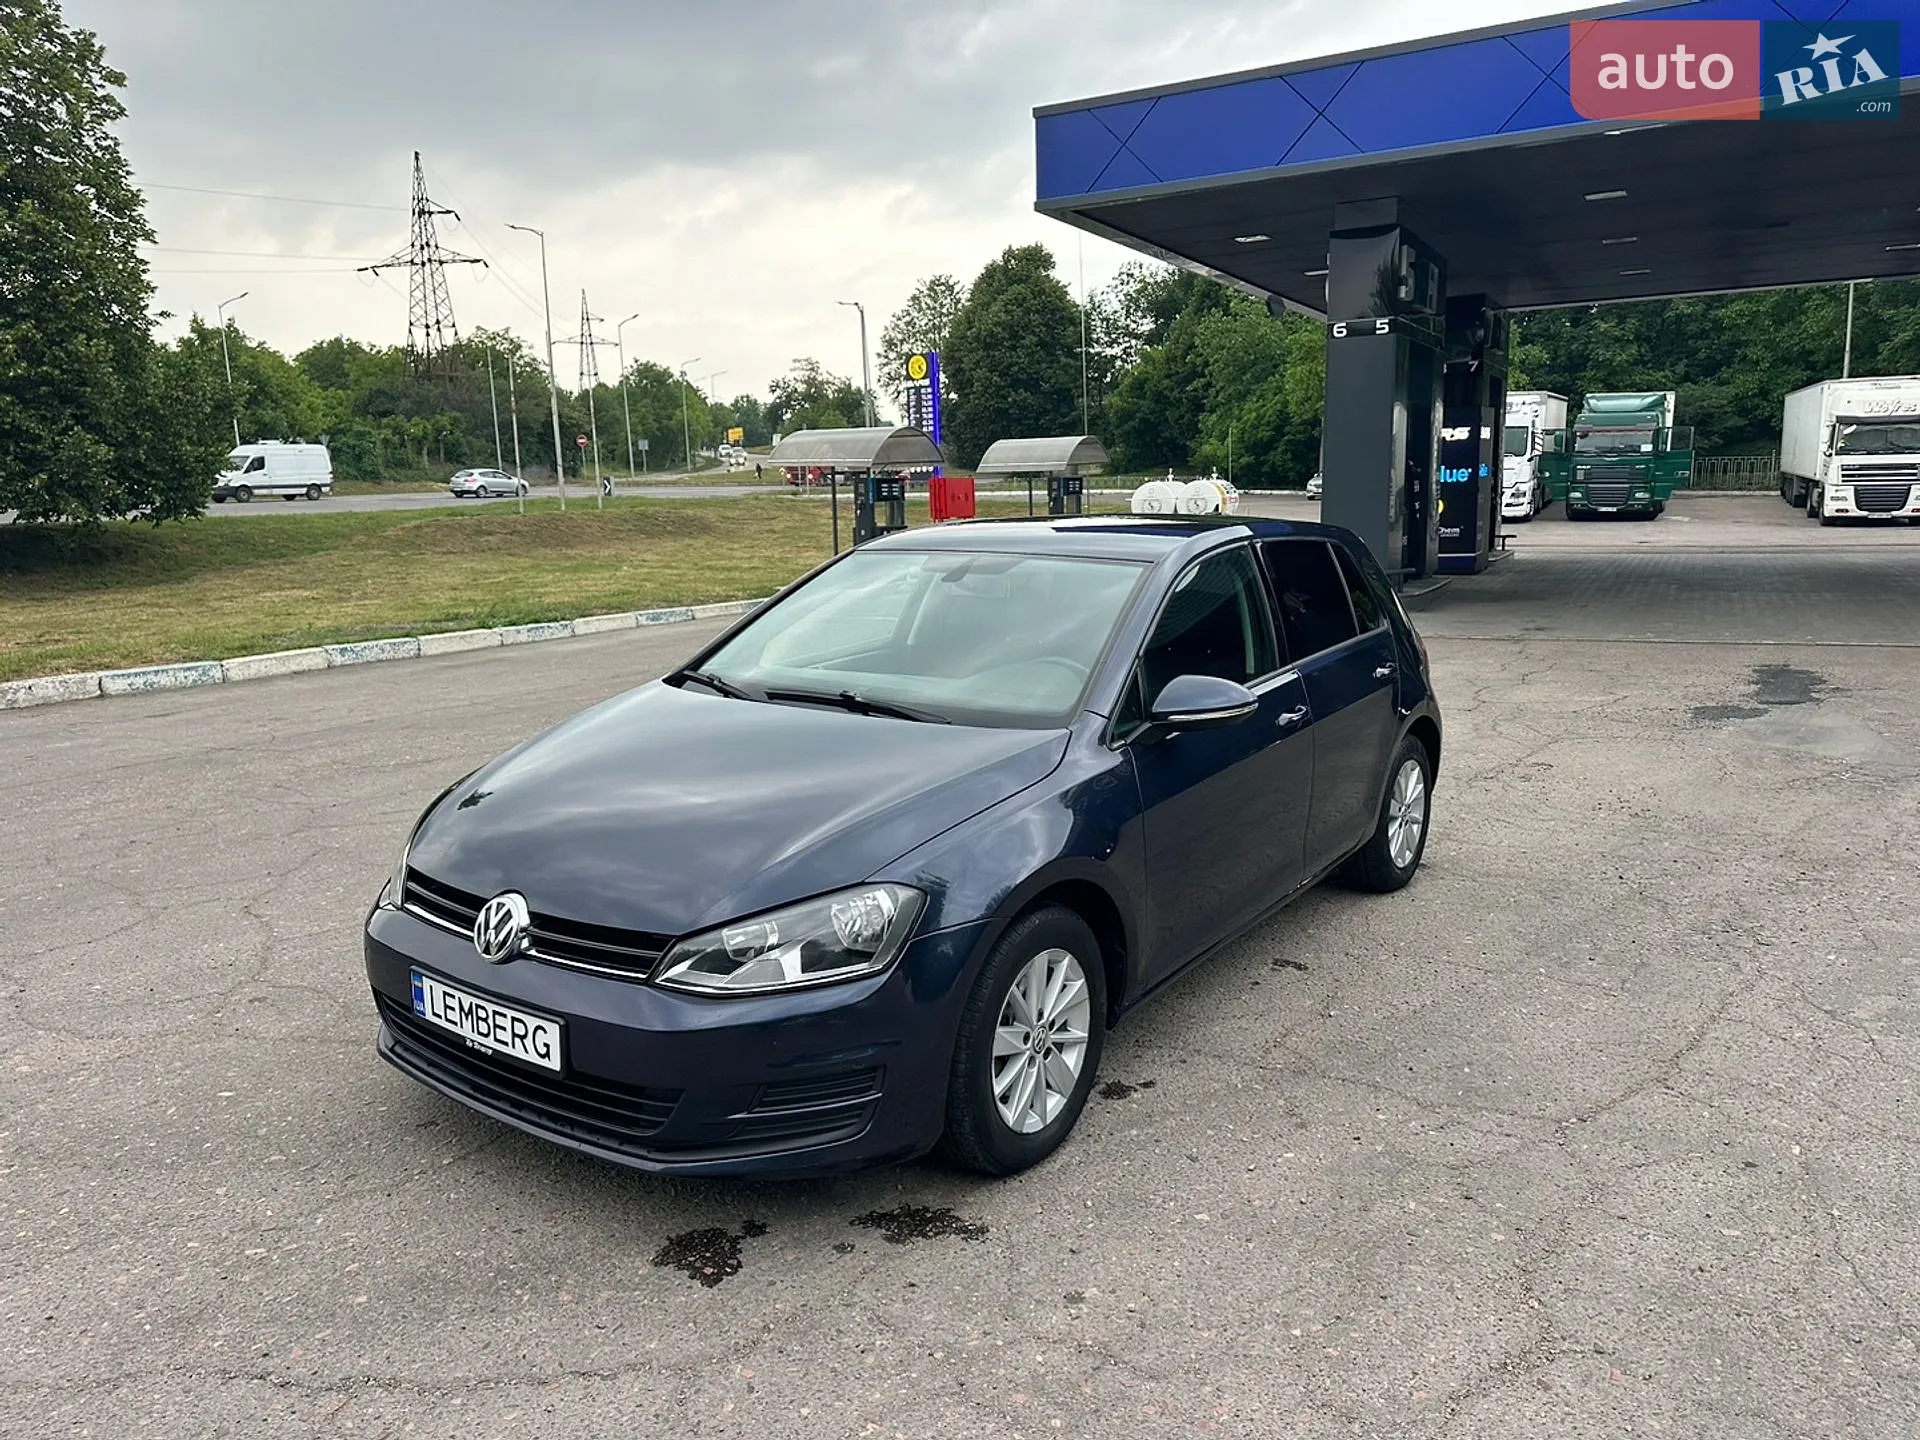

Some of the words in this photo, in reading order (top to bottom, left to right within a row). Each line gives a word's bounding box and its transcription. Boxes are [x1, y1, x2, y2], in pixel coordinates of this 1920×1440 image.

[1332, 322, 1348, 338] 6
[1375, 319, 1390, 335] 5
[1468, 360, 1479, 372] 7
[1440, 465, 1469, 483] lue
[429, 984, 551, 1061] LEMBERG
